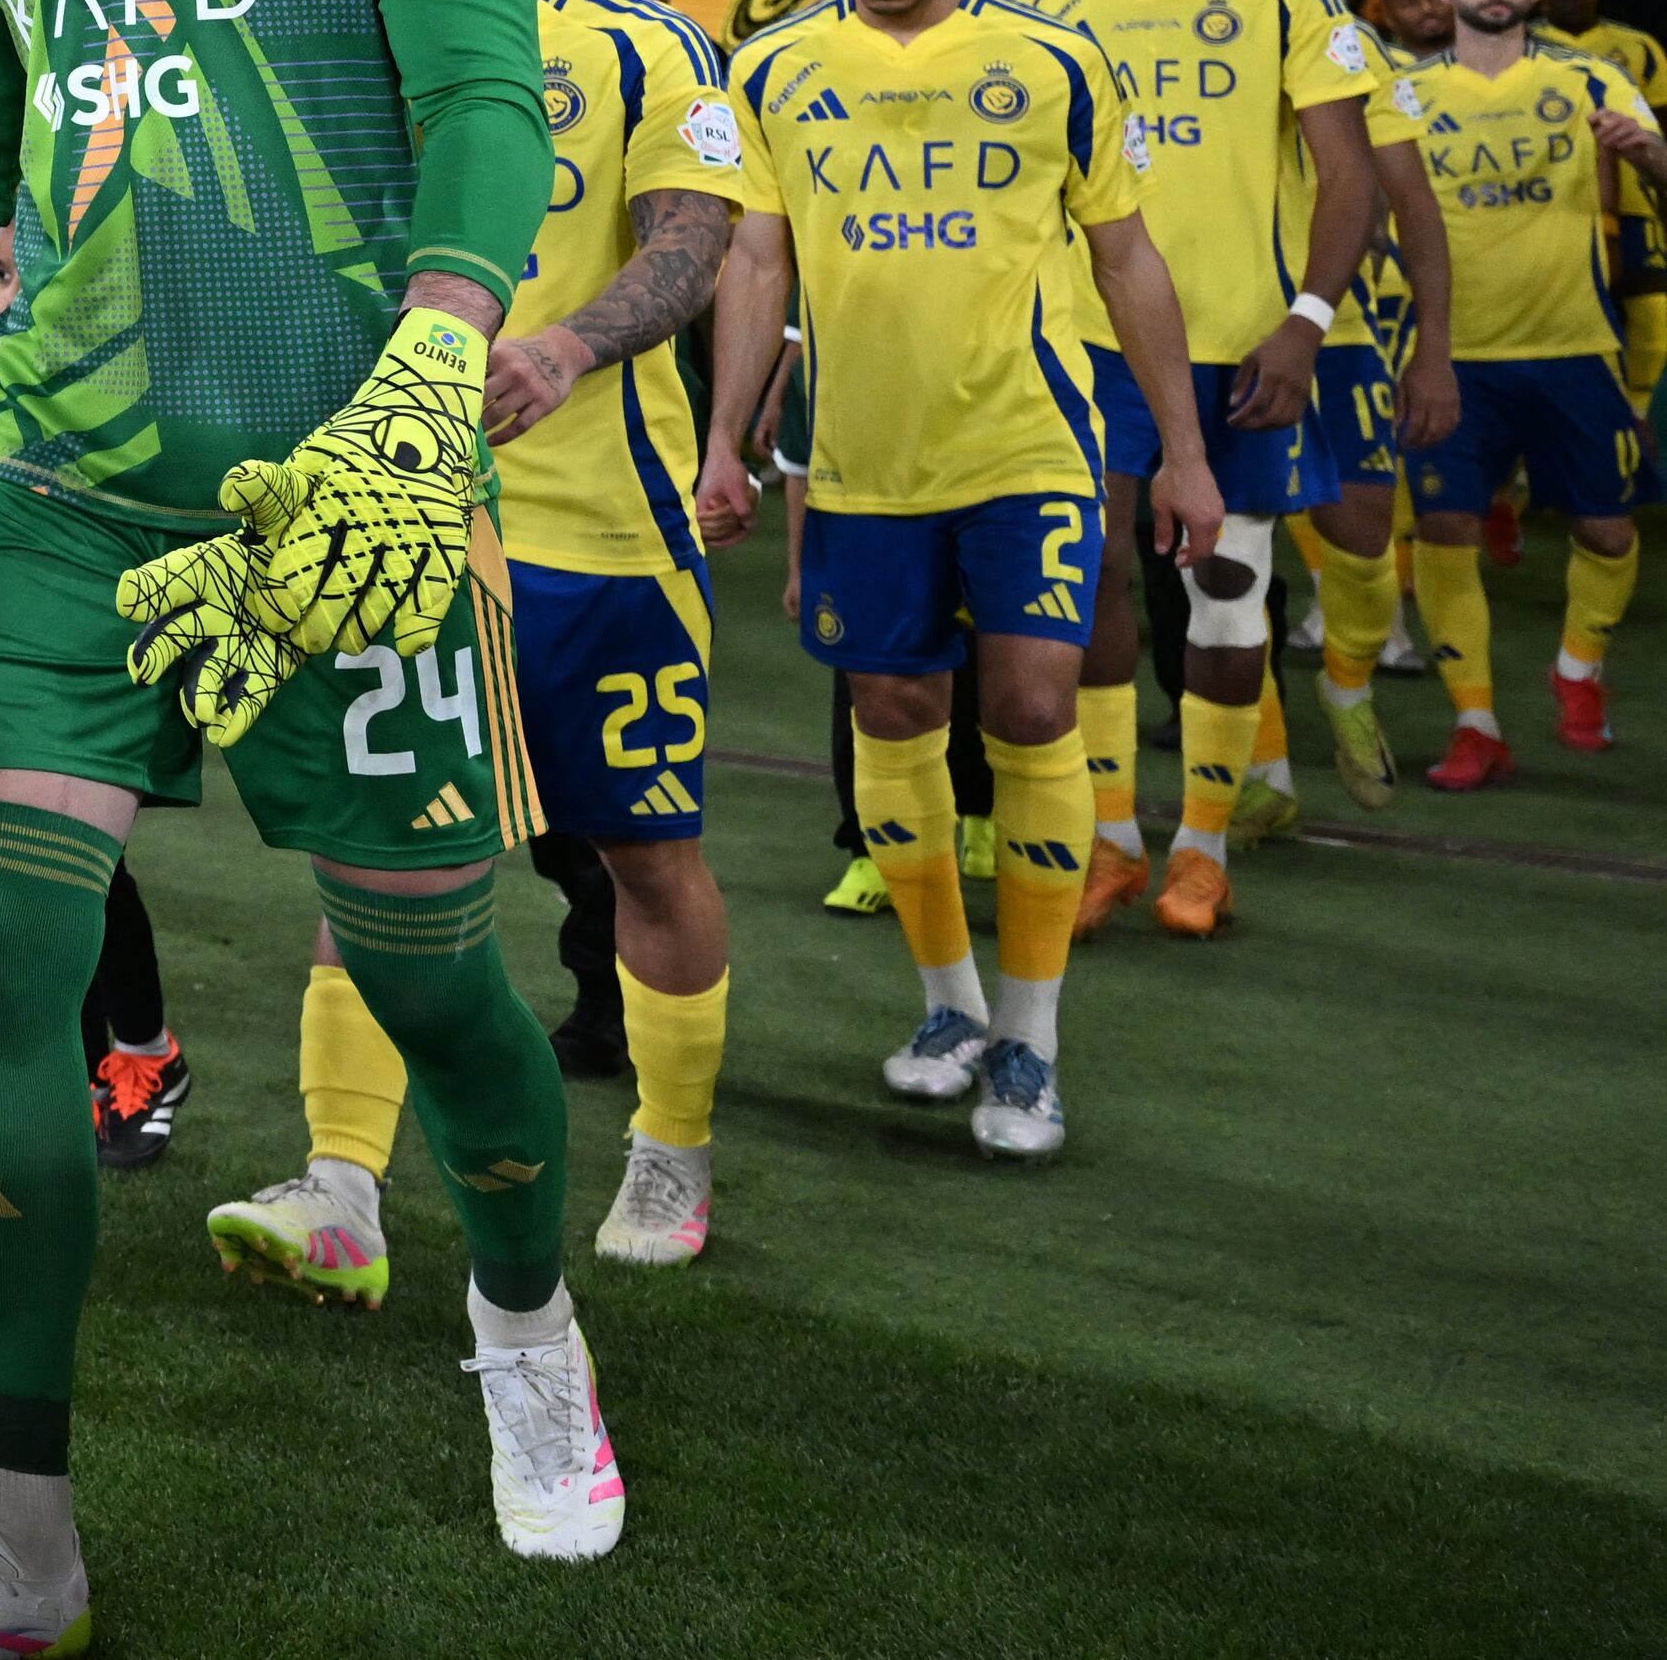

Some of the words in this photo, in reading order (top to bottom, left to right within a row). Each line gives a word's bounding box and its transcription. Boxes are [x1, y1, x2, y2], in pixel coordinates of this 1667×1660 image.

[67, 54, 200, 126] SHG
[1116, 60, 1237, 99] AFD
[705, 127, 731, 142] RSL
[1139, 115, 1202, 147] HG
[805, 141, 1021, 195] KAFD
[868, 210, 976, 251] SHG
[413, 341, 467, 374] BENTO
[1041, 501, 1083, 583] 2
[335, 644, 482, 777] 24
[595, 661, 705, 770] 25
